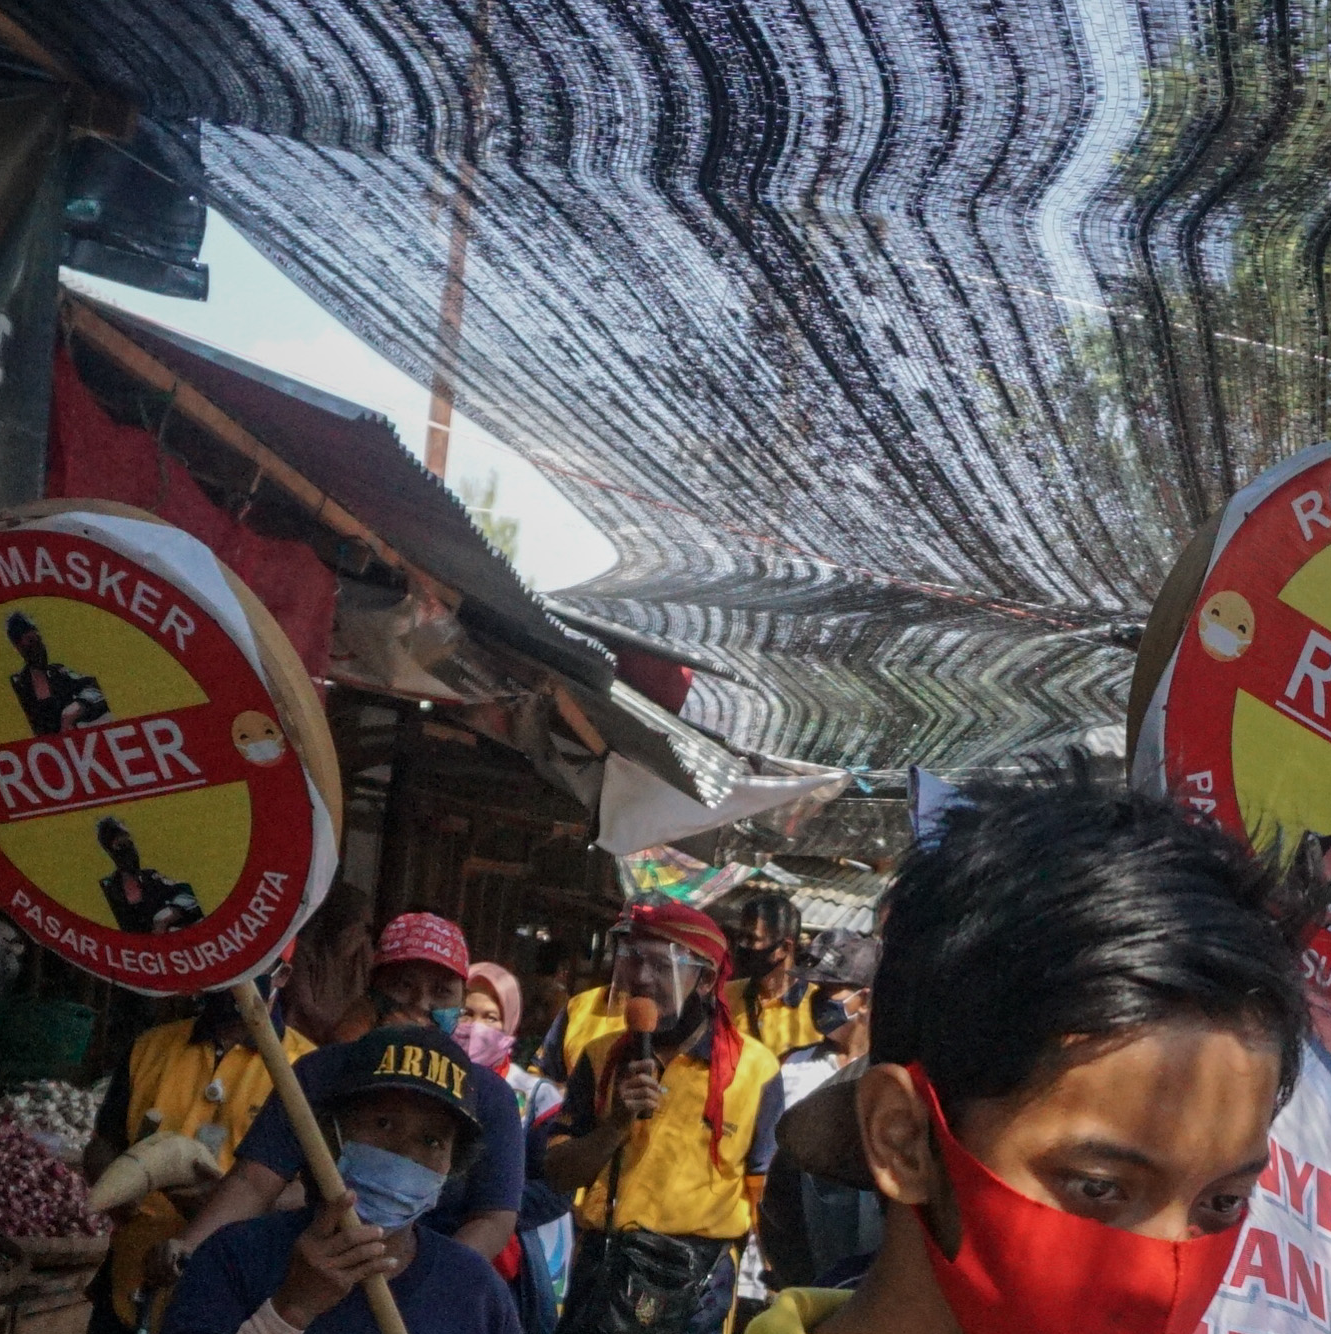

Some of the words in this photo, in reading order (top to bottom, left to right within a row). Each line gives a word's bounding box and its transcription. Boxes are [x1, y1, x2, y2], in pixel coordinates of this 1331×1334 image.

[11, 889, 99, 961] PASAR
[105, 944, 168, 976] LEGI
[169, 868, 289, 975] SURAKARTA
[373, 1044, 467, 1099] ARMY
